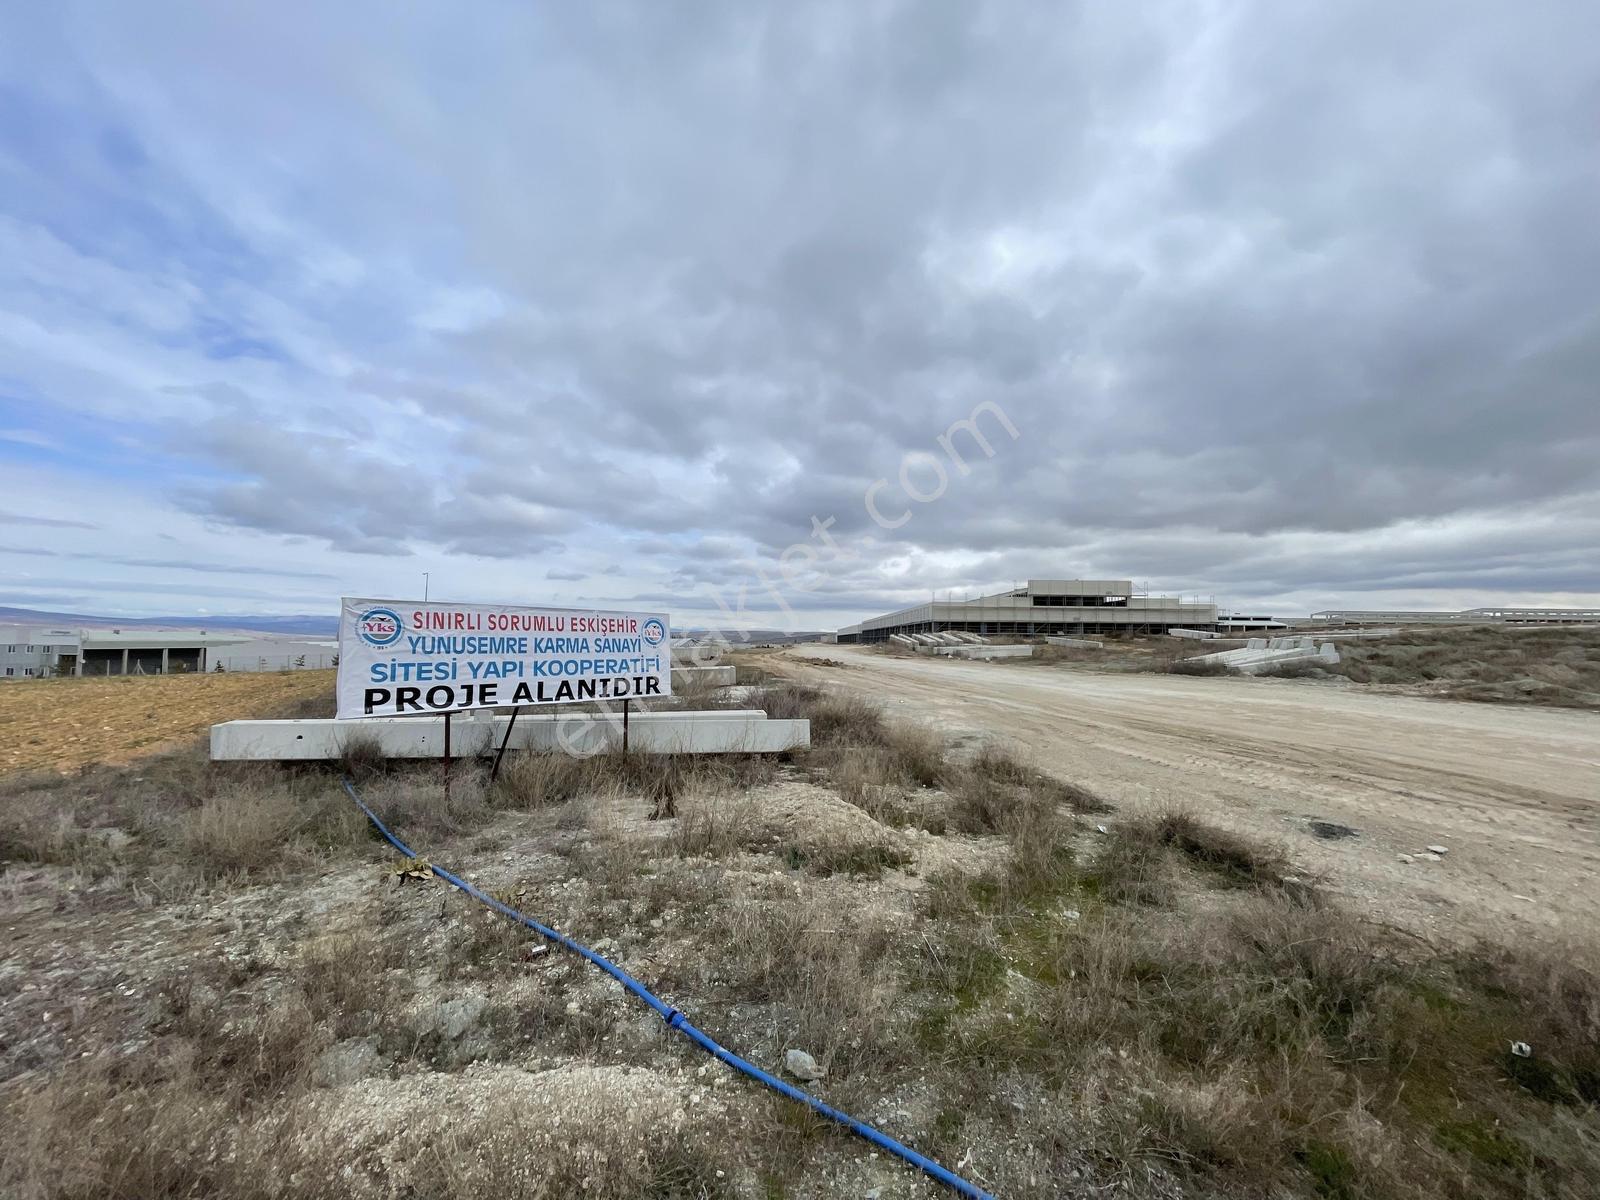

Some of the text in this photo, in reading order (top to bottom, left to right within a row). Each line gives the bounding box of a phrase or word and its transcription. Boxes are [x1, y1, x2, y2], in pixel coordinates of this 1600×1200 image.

[413, 611, 481, 632] SINIRLI
[488, 614, 565, 632] SORUMLU
[570, 614, 637, 636] ESKİŞEHİR
[408, 635, 641, 655] YUNUSEMRE KARMA SANAYİ
[370, 654, 660, 683] SİTESİ YAPI KOOPERATİFİ
[364, 676, 661, 715] PROJE ALANIDIR
